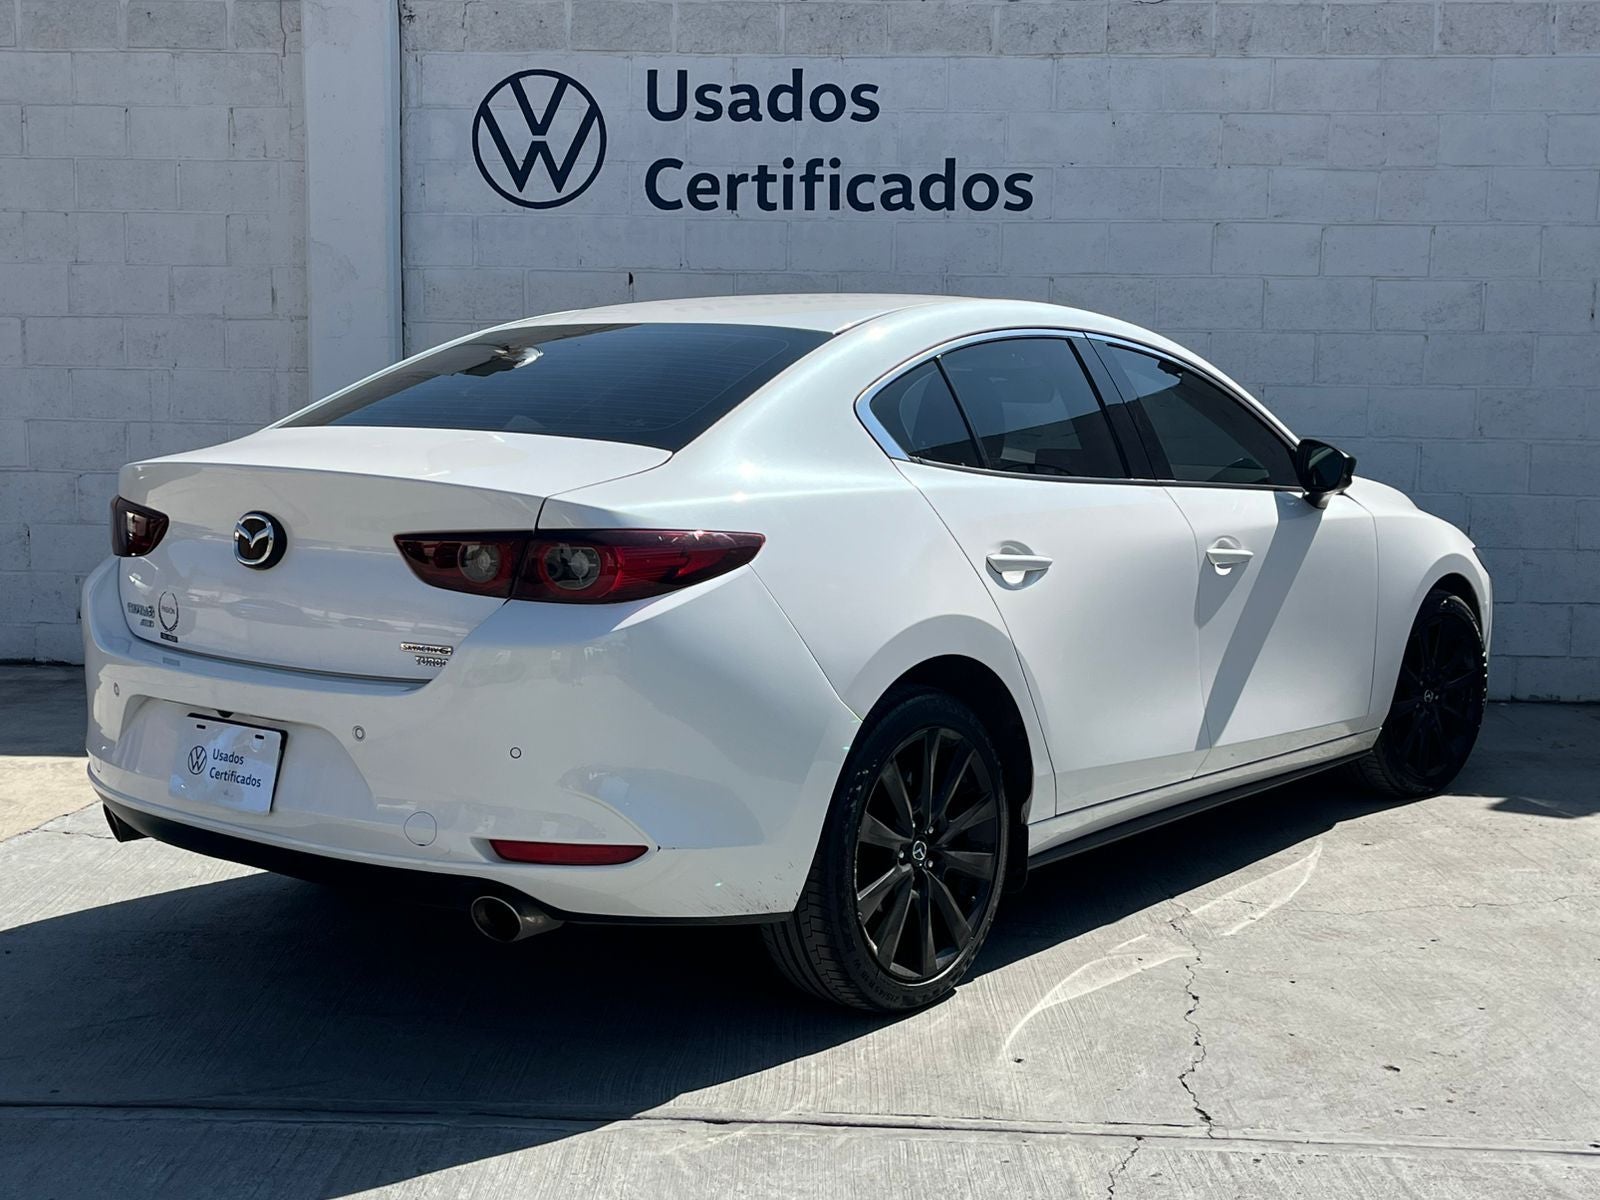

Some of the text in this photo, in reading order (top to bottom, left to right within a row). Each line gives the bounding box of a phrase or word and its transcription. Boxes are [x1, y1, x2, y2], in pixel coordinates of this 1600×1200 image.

[647, 68, 880, 123] Usados
[645, 157, 1034, 213] Certificados
[212, 748, 245, 765] Usados
[209, 766, 262, 788] Certificados
